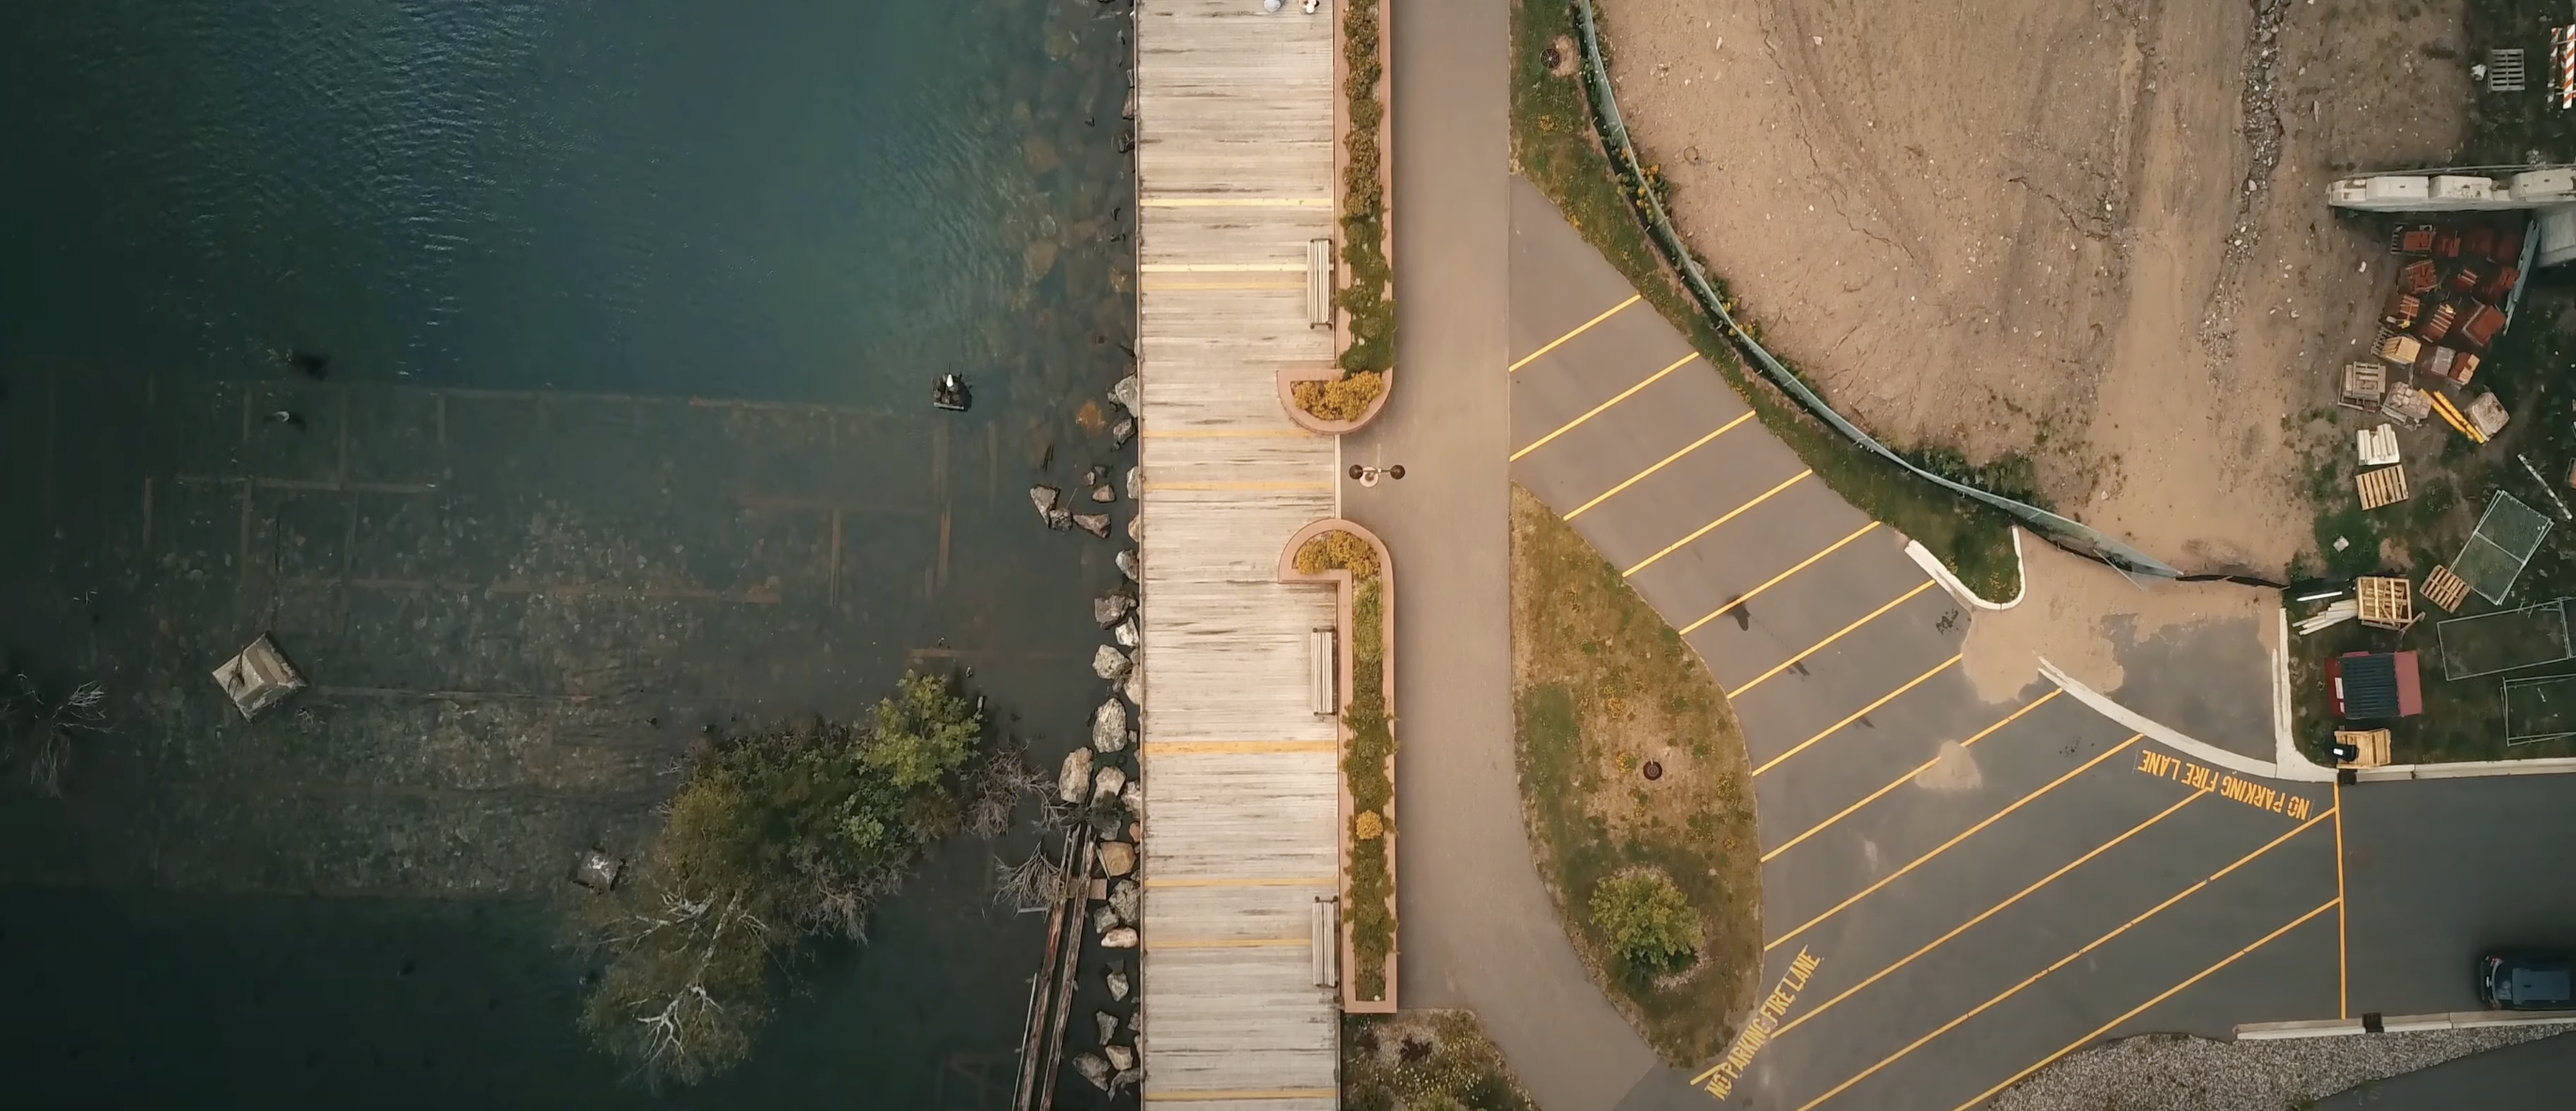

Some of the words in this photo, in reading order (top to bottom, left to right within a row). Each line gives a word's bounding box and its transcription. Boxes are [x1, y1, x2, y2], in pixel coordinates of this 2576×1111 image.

[2137, 749, 2182, 781] LANE
[2181, 763, 2220, 792] FIRE
[2220, 775, 2286, 813] PARKING
[2287, 796, 2310, 820] NO
[1705, 1071, 1733, 1101] NO
[1760, 985, 1796, 1025] FIRE
[1783, 947, 1821, 991] LANE
